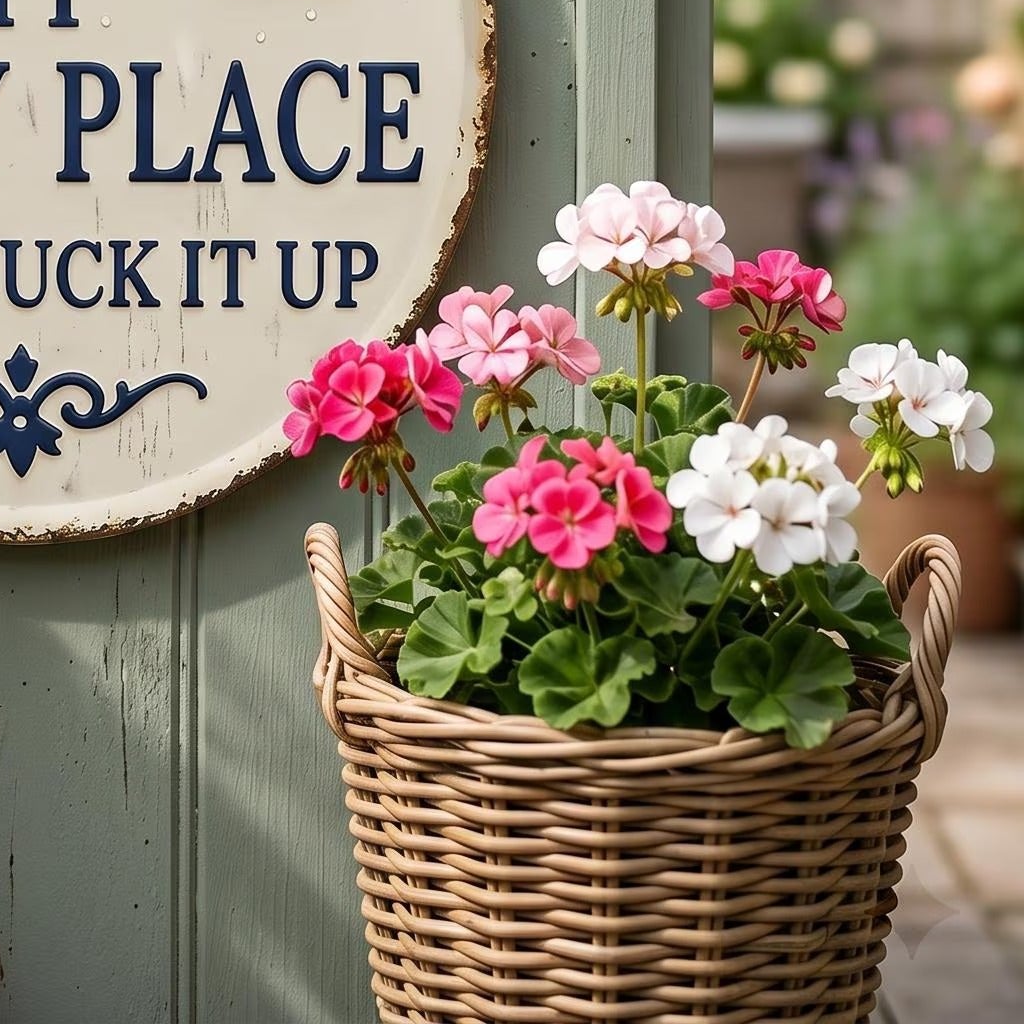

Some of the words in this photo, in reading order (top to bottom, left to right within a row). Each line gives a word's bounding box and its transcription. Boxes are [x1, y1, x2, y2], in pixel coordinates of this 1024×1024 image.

[55, 59, 424, 186] PLACE
[180, 239, 256, 308] IT
[275, 240, 379, 310] UP
